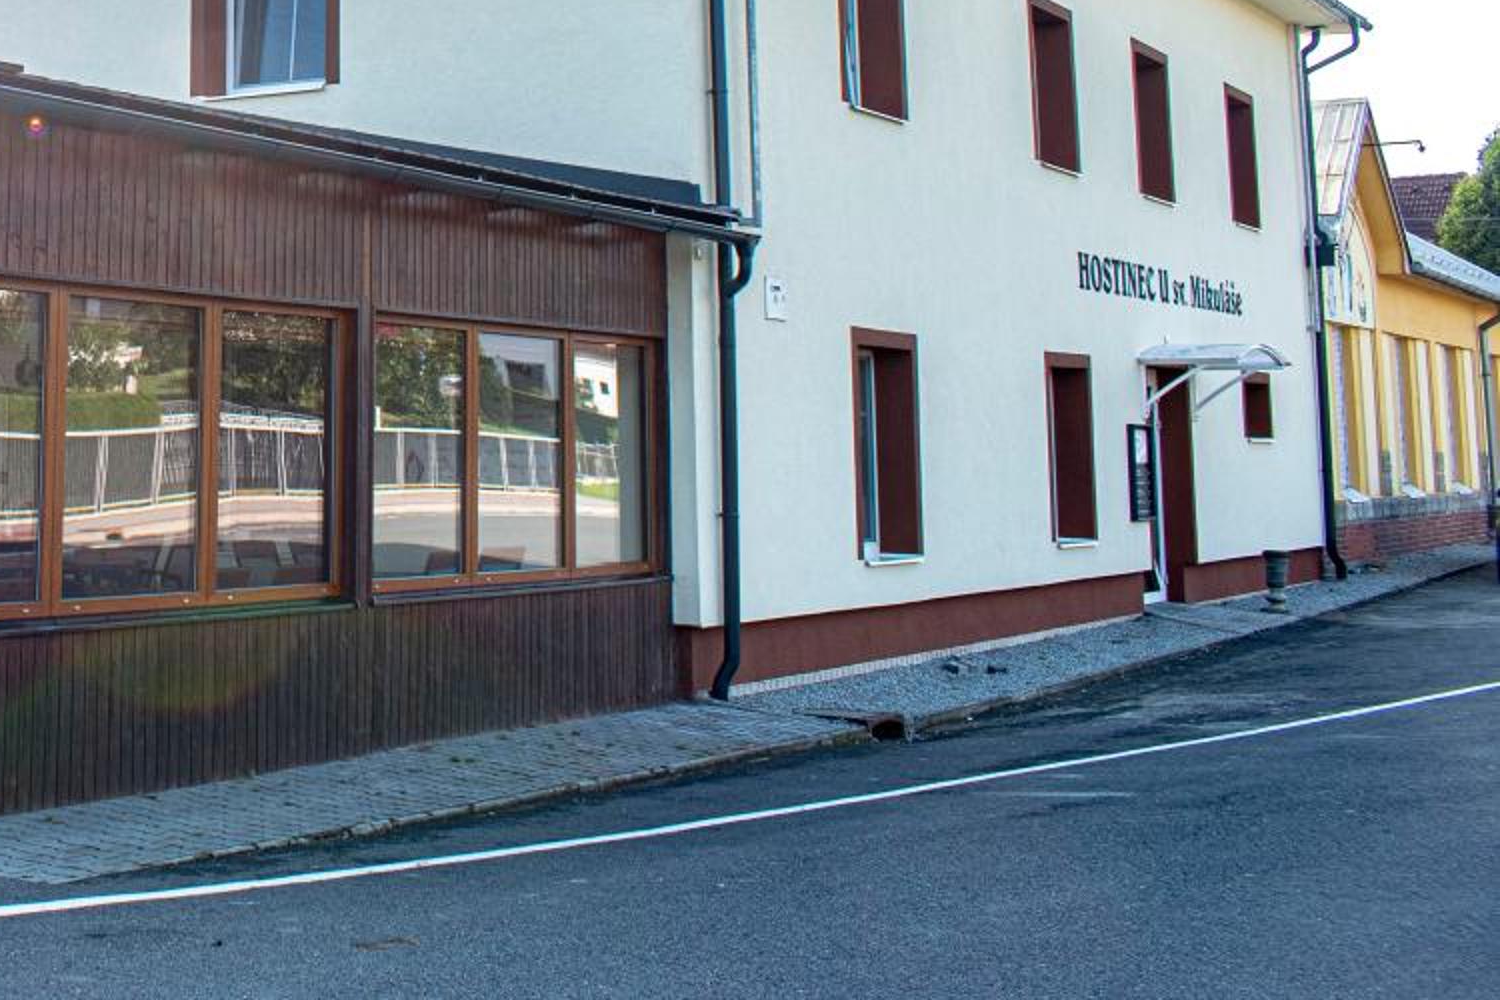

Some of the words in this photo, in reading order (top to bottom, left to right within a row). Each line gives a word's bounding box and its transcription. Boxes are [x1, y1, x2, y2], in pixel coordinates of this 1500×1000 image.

[1077, 251, 1156, 302] HOSTINEC
[1157, 269, 1170, 304] U
[1173, 279, 1188, 306] sv.
